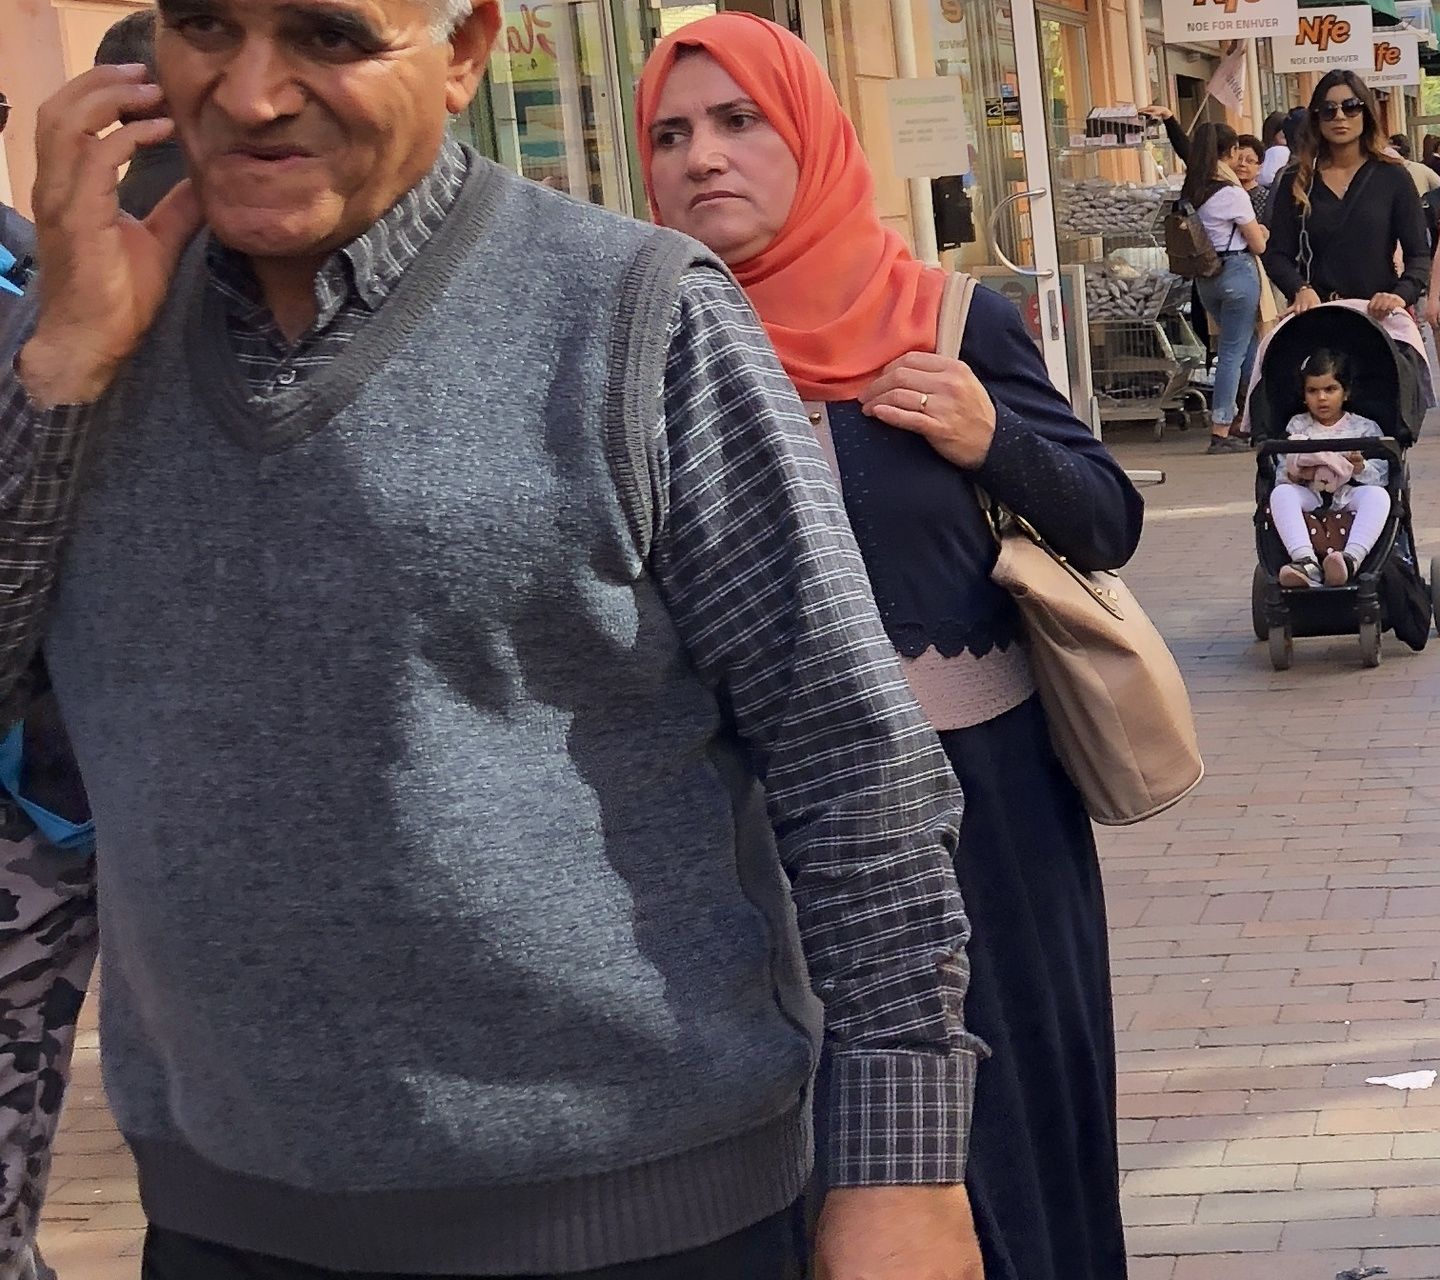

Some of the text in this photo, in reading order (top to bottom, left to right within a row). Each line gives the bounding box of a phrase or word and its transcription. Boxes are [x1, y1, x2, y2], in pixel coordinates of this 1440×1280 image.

[1187, 18, 1279, 32] NOE FOR ENHVER
[1295, 14, 1351, 51] Nfe
